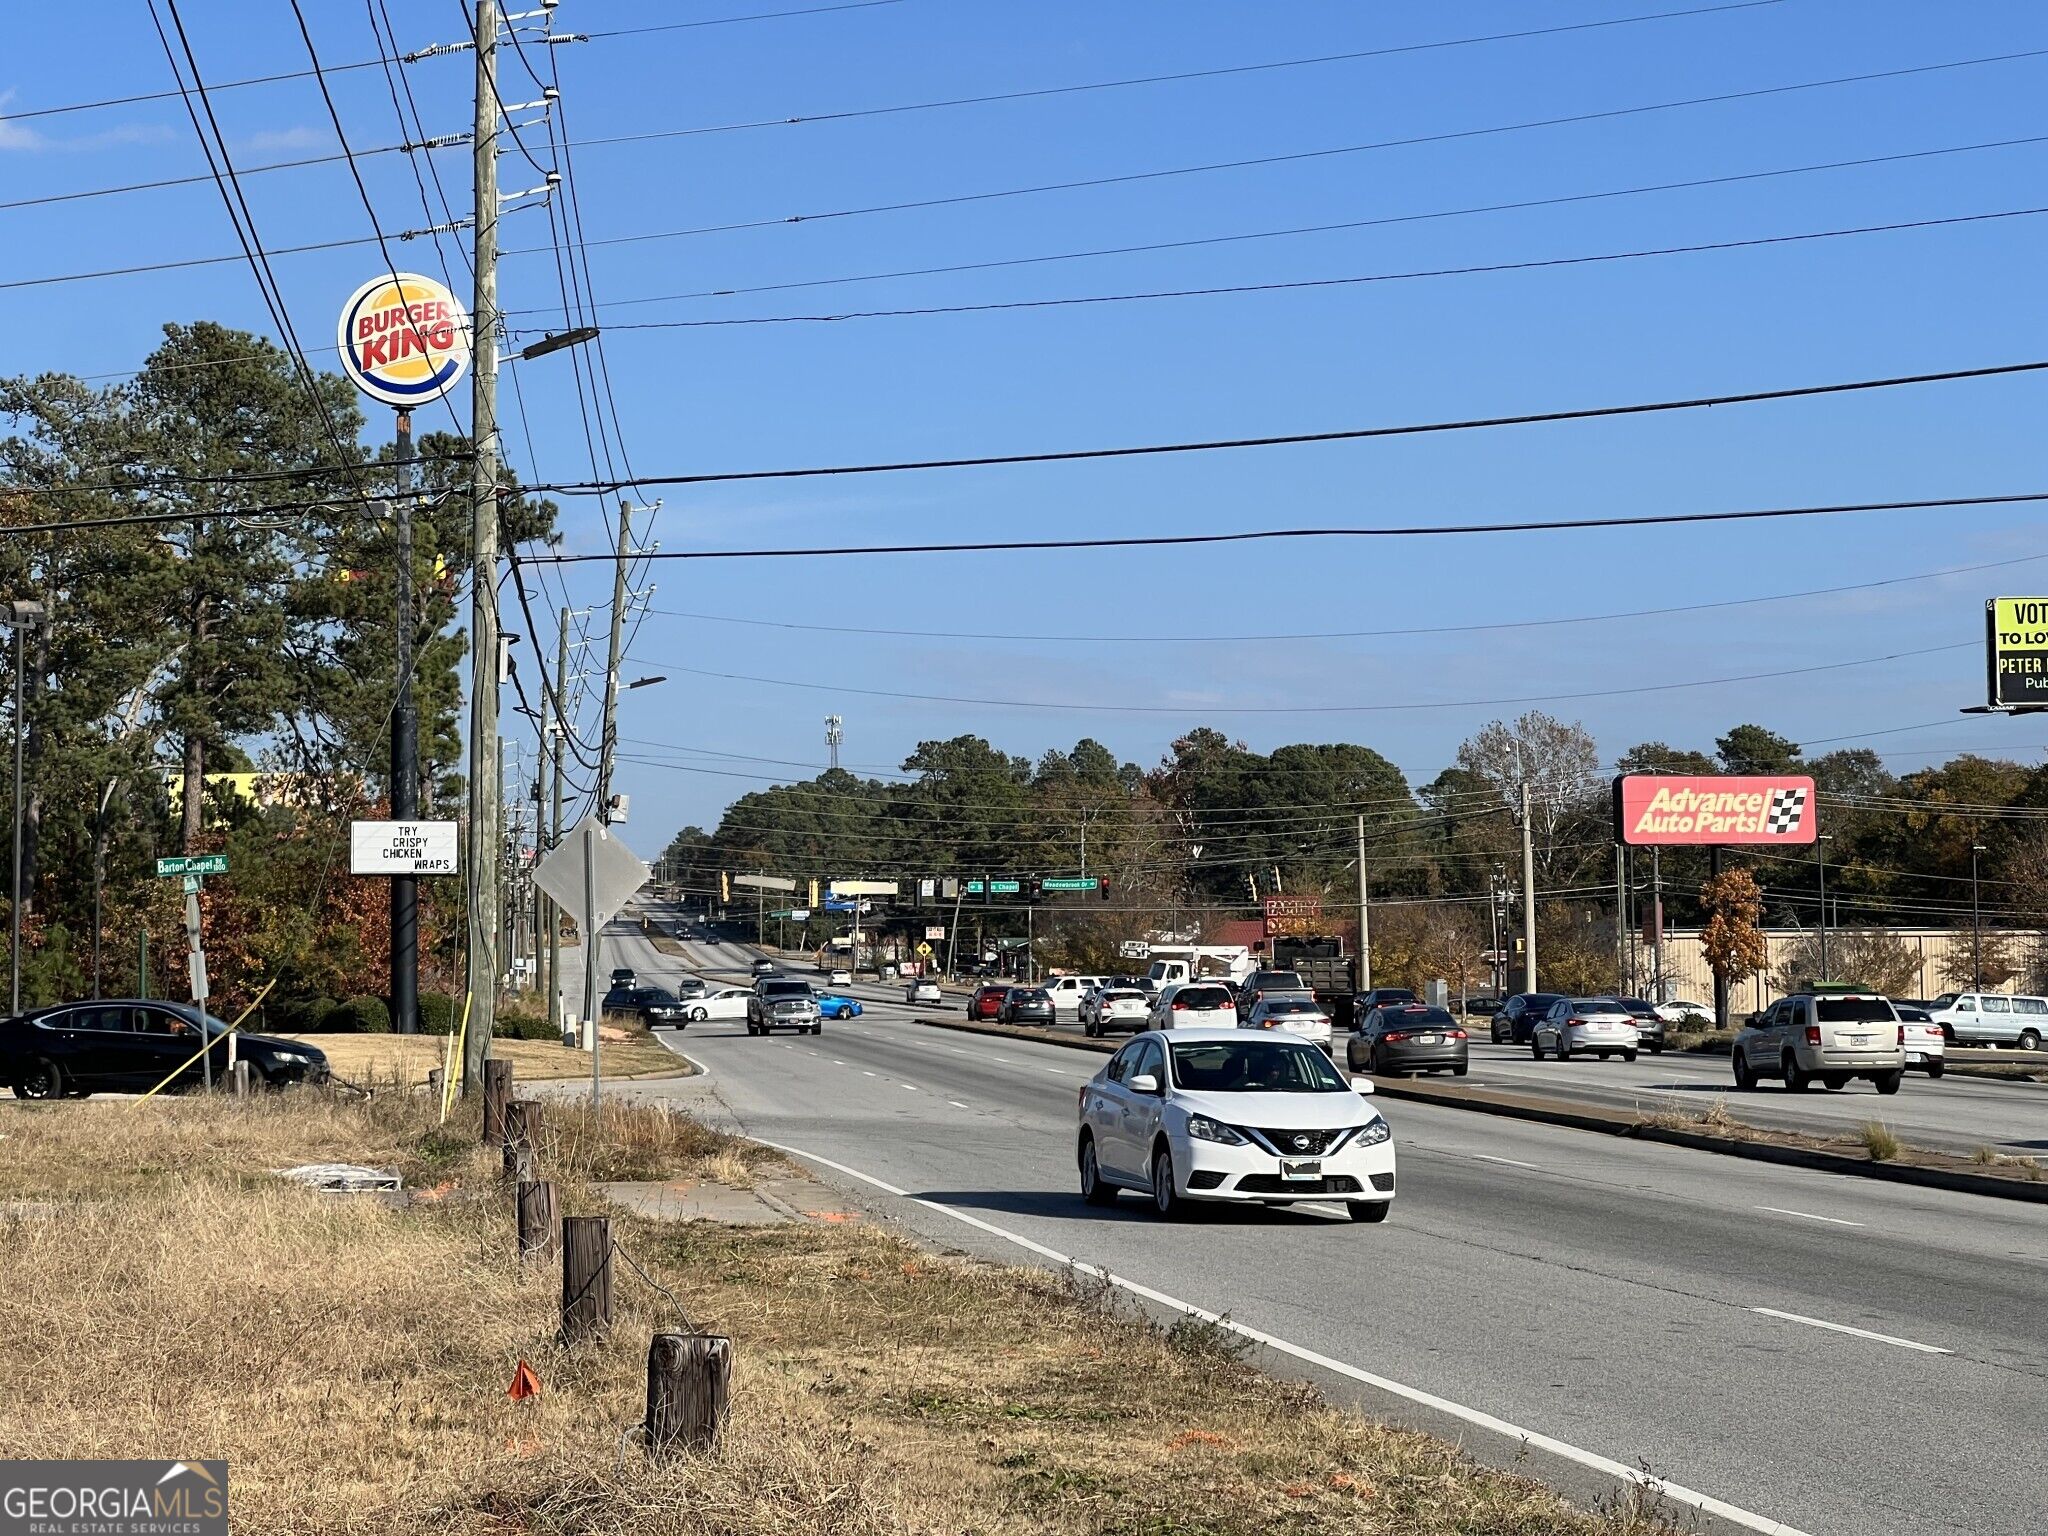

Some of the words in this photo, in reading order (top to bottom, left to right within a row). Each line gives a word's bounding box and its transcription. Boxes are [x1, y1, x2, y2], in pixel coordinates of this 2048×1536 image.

[359, 301, 449, 340] BURGER
[362, 320, 454, 371] KING
[1999, 632, 2021, 645] TO
[2025, 632, 2048, 644] LO
[1999, 657, 2042, 674] PETER
[1646, 787, 1762, 813] Advance
[1634, 812, 1694, 833] Auto
[1694, 812, 1758, 833] Parts
[398, 826, 418, 836] TRY
[392, 837, 429, 848] CRISPY
[382, 848, 422, 859] CHICKEN
[157, 860, 185, 874] Barton
[184, 858, 213, 873] Chapel
[414, 860, 450, 870] WRAPS
